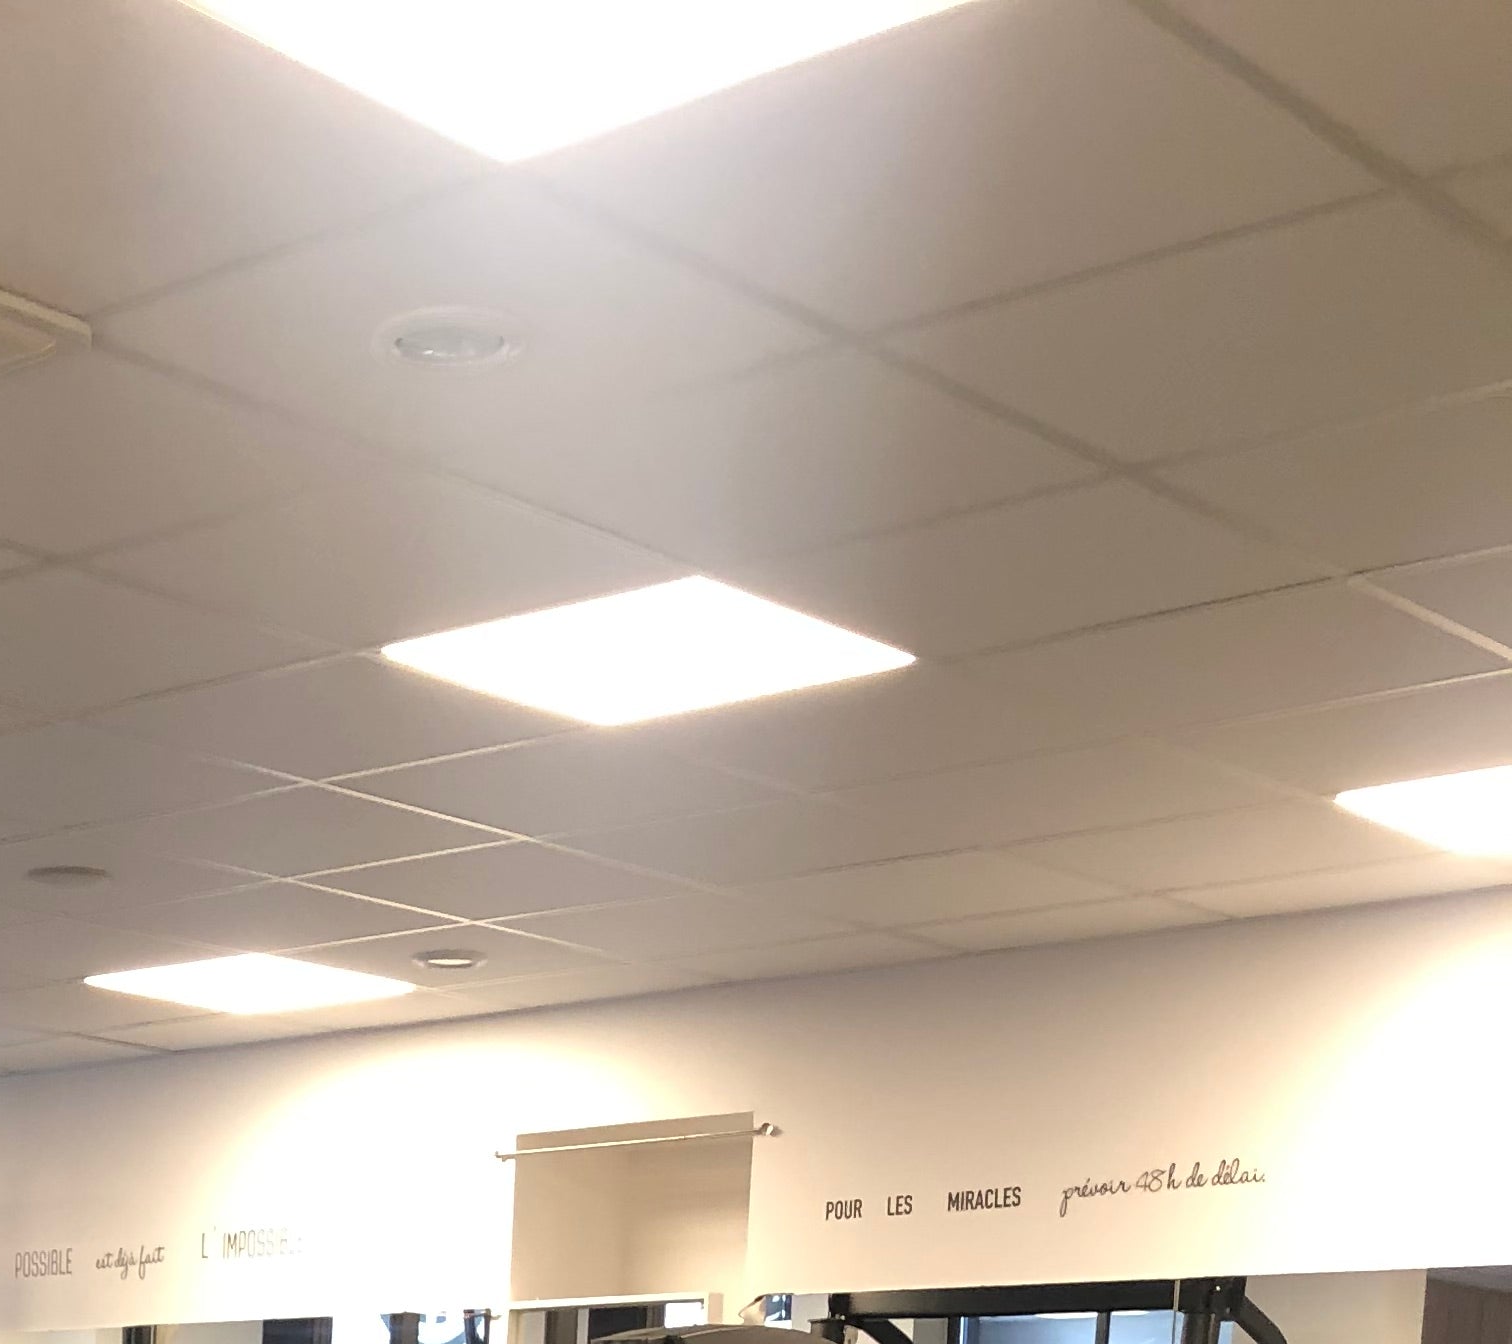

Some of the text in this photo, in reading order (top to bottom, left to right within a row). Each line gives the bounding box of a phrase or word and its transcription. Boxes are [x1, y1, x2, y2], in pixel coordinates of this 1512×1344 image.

[825, 1198, 863, 1221] POUR
[887, 1194, 913, 1216] LES
[947, 1186, 1022, 1212] MIRACLES
[1059, 1177, 1131, 1218] prévoir
[1186, 1161, 1209, 1188] de
[15, 1247, 73, 1279] POSSIBLE
[96, 1252, 114, 1270] est
[115, 1247, 137, 1280] déjà
[138, 1245, 166, 1280] fait
